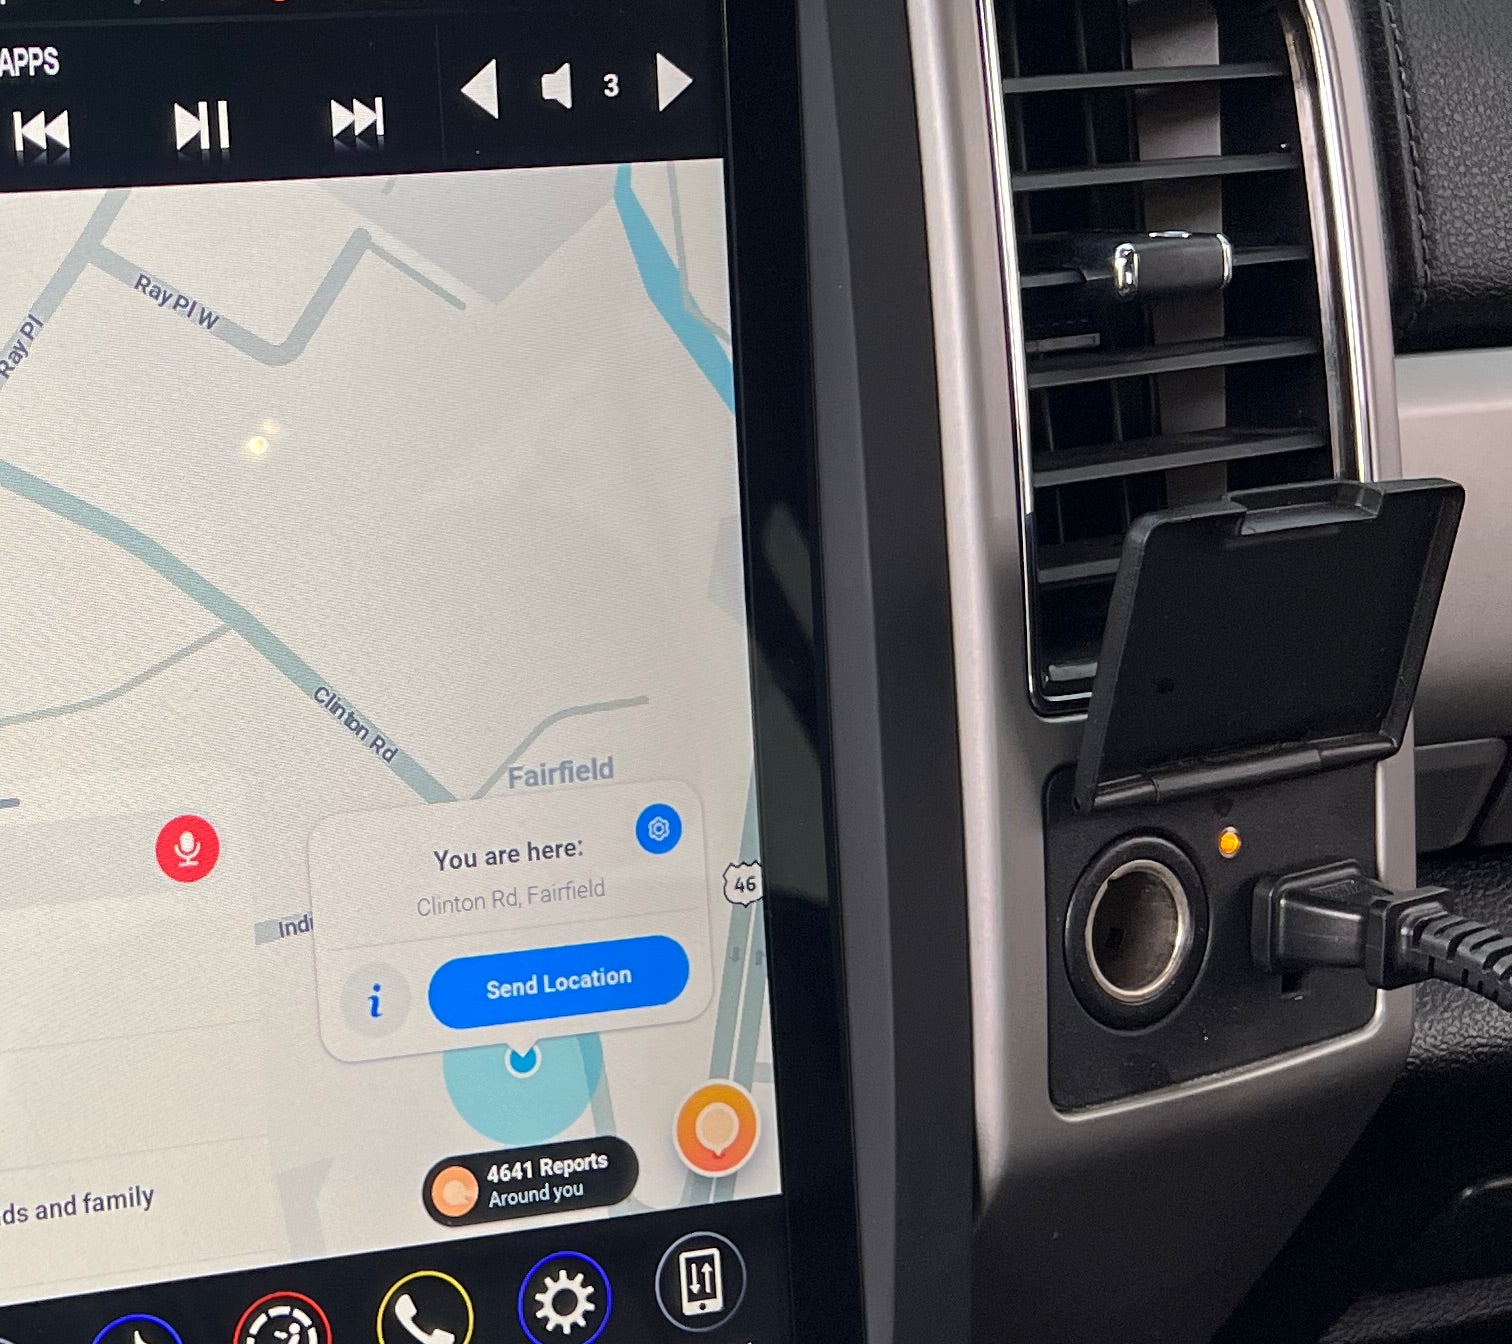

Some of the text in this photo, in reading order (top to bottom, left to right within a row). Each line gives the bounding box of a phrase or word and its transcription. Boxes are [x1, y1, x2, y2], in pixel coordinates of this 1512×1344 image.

[602, 72, 620, 98] 3
[134, 272, 221, 330] Ray Pl W
[19, 313, 44, 343] Pl
[313, 685, 398, 765] Clinton Rd
[507, 756, 615, 789] Fairfield
[432, 838, 585, 872] You are here:
[416, 878, 606, 918] Clinton Rd, Fairfield
[733, 875, 758, 894] 46
[486, 963, 633, 1001] Send Location
[486, 1151, 609, 1185] 4641 Reports
[35, 1194, 79, 1222] and
[82, 1184, 156, 1217] family
[488, 1180, 585, 1209] Around you
